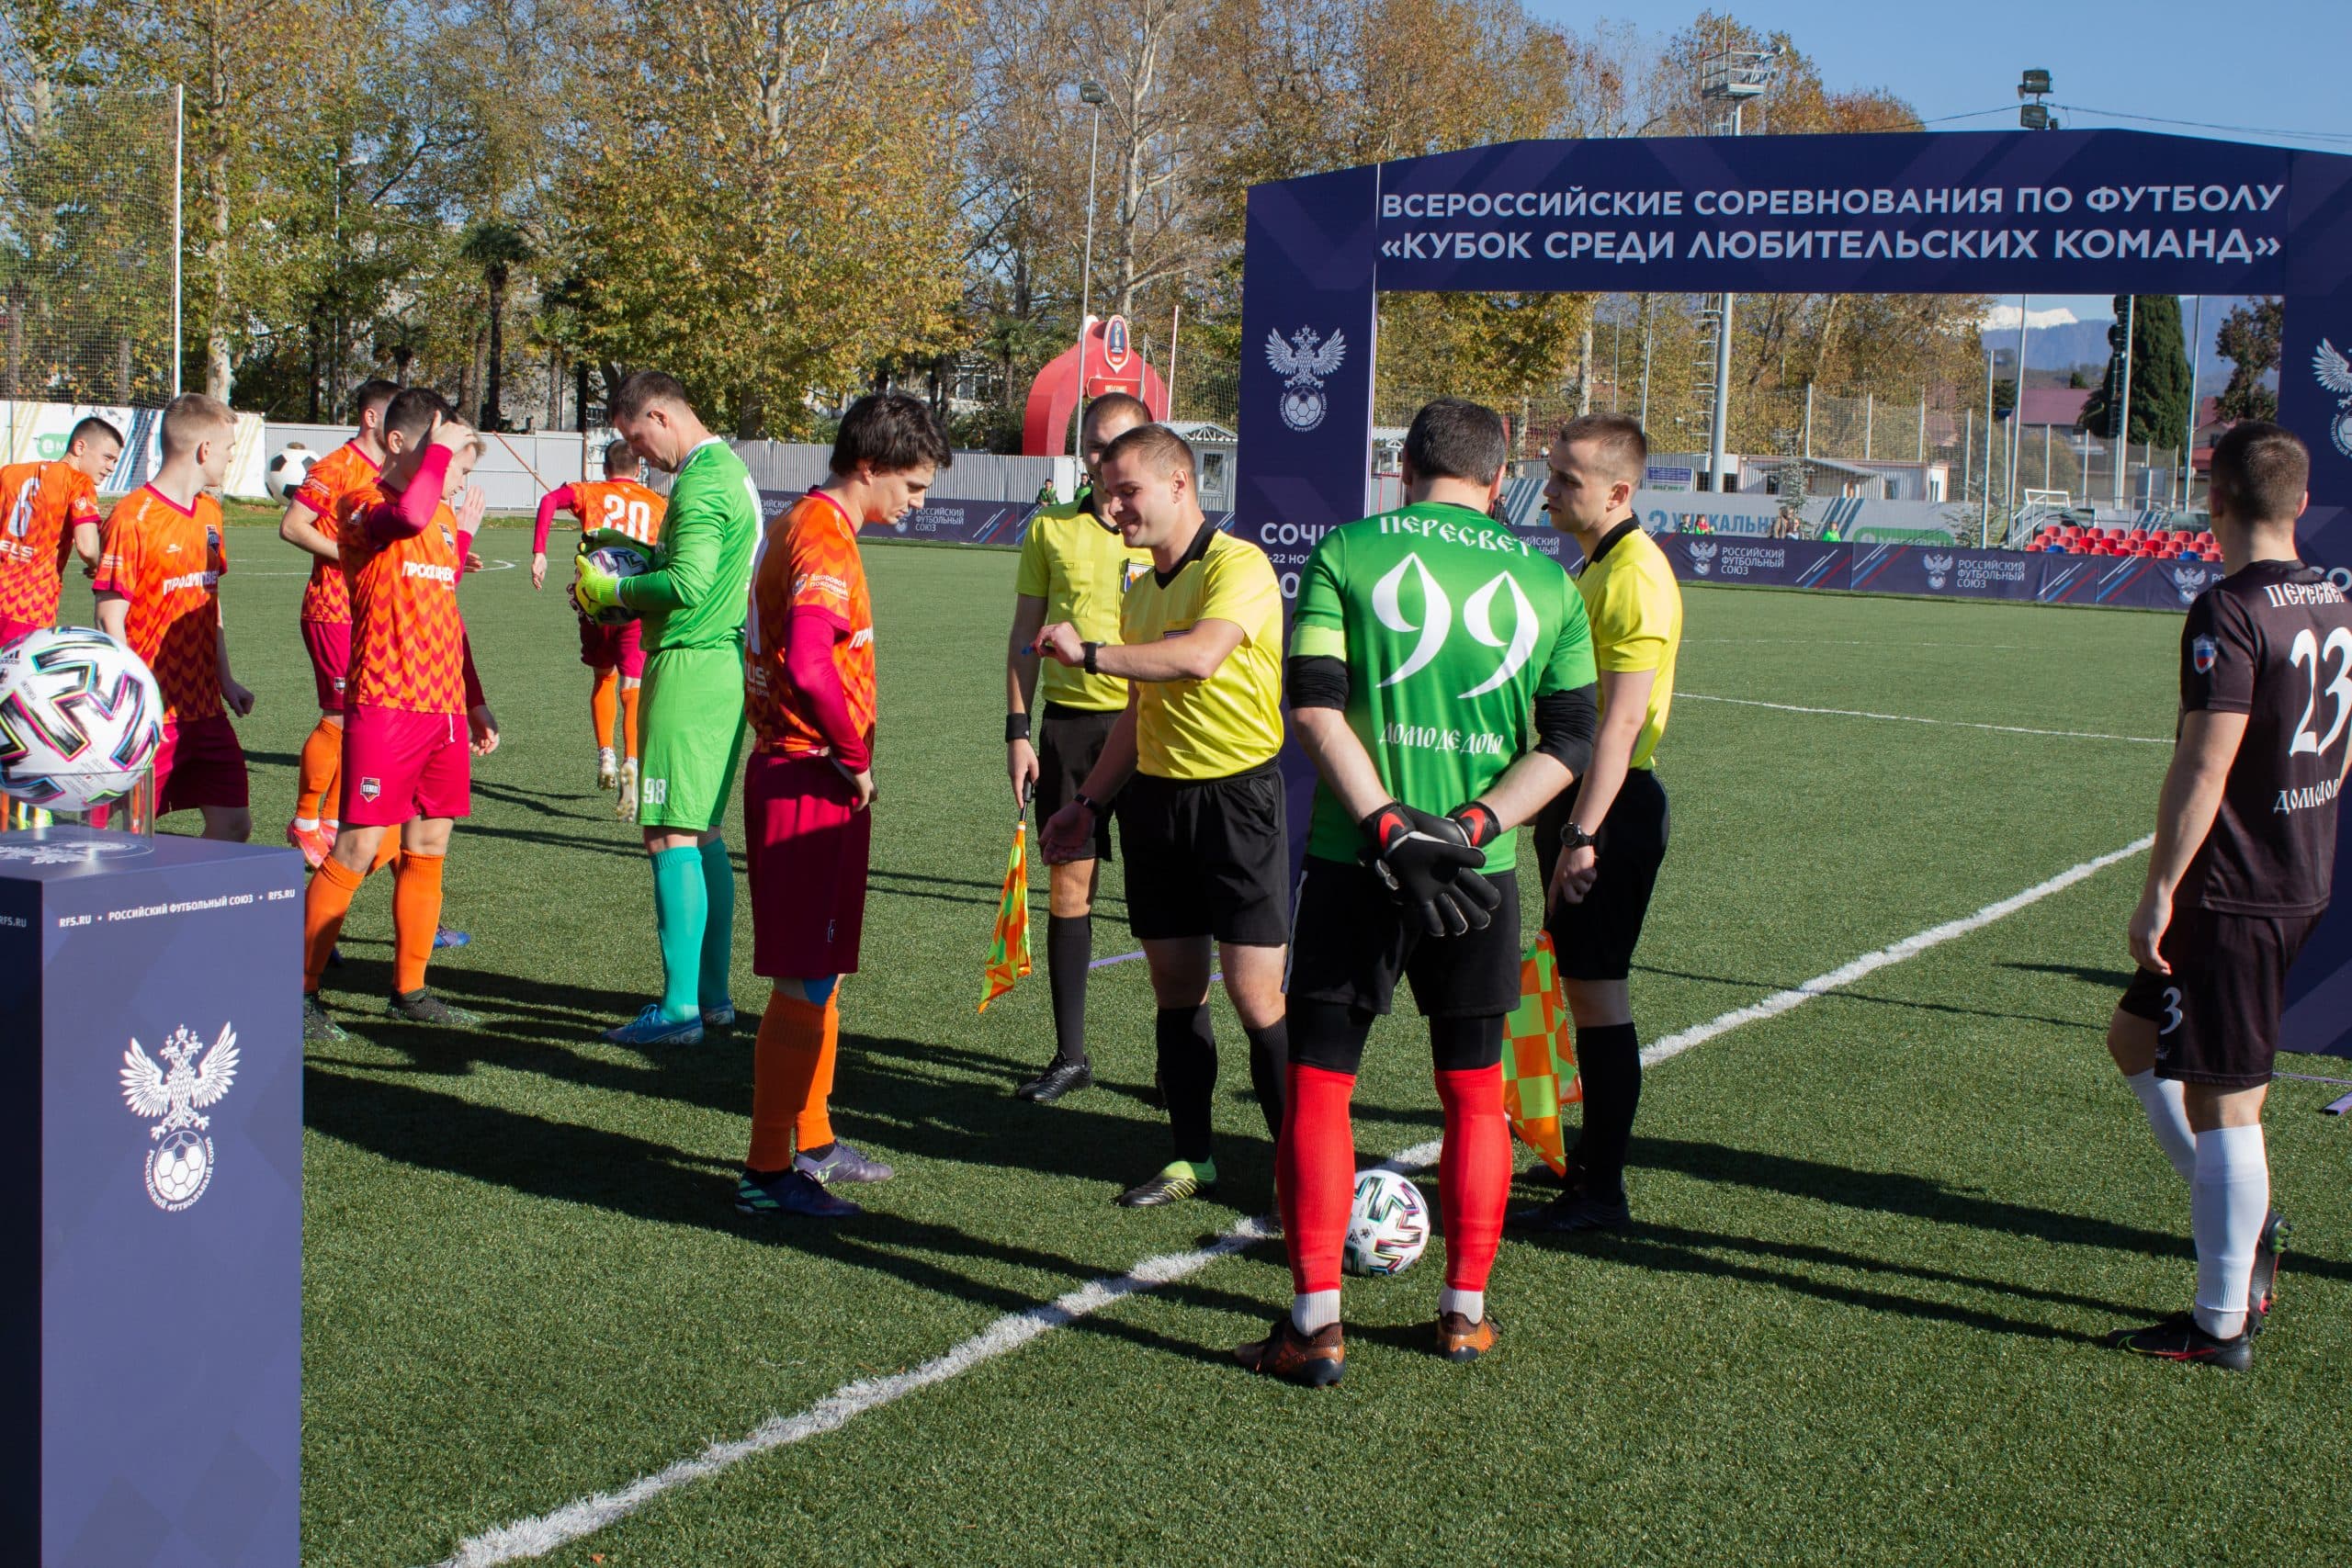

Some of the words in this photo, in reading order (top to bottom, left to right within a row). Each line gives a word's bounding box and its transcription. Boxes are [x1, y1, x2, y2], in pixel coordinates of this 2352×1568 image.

[1383, 186, 1683, 218] ВСЕРОССИЙСКИЕ
[1694, 187, 2003, 216] СОРЕВНОВАНИЯ
[2016, 186, 2074, 213] ПО
[2086, 184, 2284, 212] ФУТБОЛУ
[1381, 231, 1532, 259] «КУБОК
[1544, 231, 1674, 264] СРЕДИ
[1687, 230, 2039, 259] ЛЮБИТЕЛЬСКИХ
[2054, 229, 2281, 264] КОМАНД»
[602, 493, 651, 544] 20
[915, 523, 937, 532] СОЮЗ
[1379, 514, 1530, 558] ПЕРЕСВЕТ
[1721, 555, 1785, 568] ФУТБОЛЬНЫЙ
[1722, 546, 1785, 558] РОССИЙСКИЙ
[1958, 559, 2026, 571] РОССИЙСКИЙ
[1720, 564, 1749, 575] СОЮЗ
[1957, 569, 2026, 581] ФУТБОЛЬНЫЙ
[1956, 578, 1987, 589] СОЮЗ
[1372, 551, 1540, 699] 99
[2289, 626, 2352, 758] 23
[643, 778, 667, 805] 98
[59, 914, 92, 928] RFS.RU
[107, 904, 168, 921] РОССИЙСКИЙ
[169, 896, 228, 913] ФУТБОЛЬНЫЙ
[229, 894, 254, 906] СОЮЗ
[268, 888, 296, 900] RFS.RU
